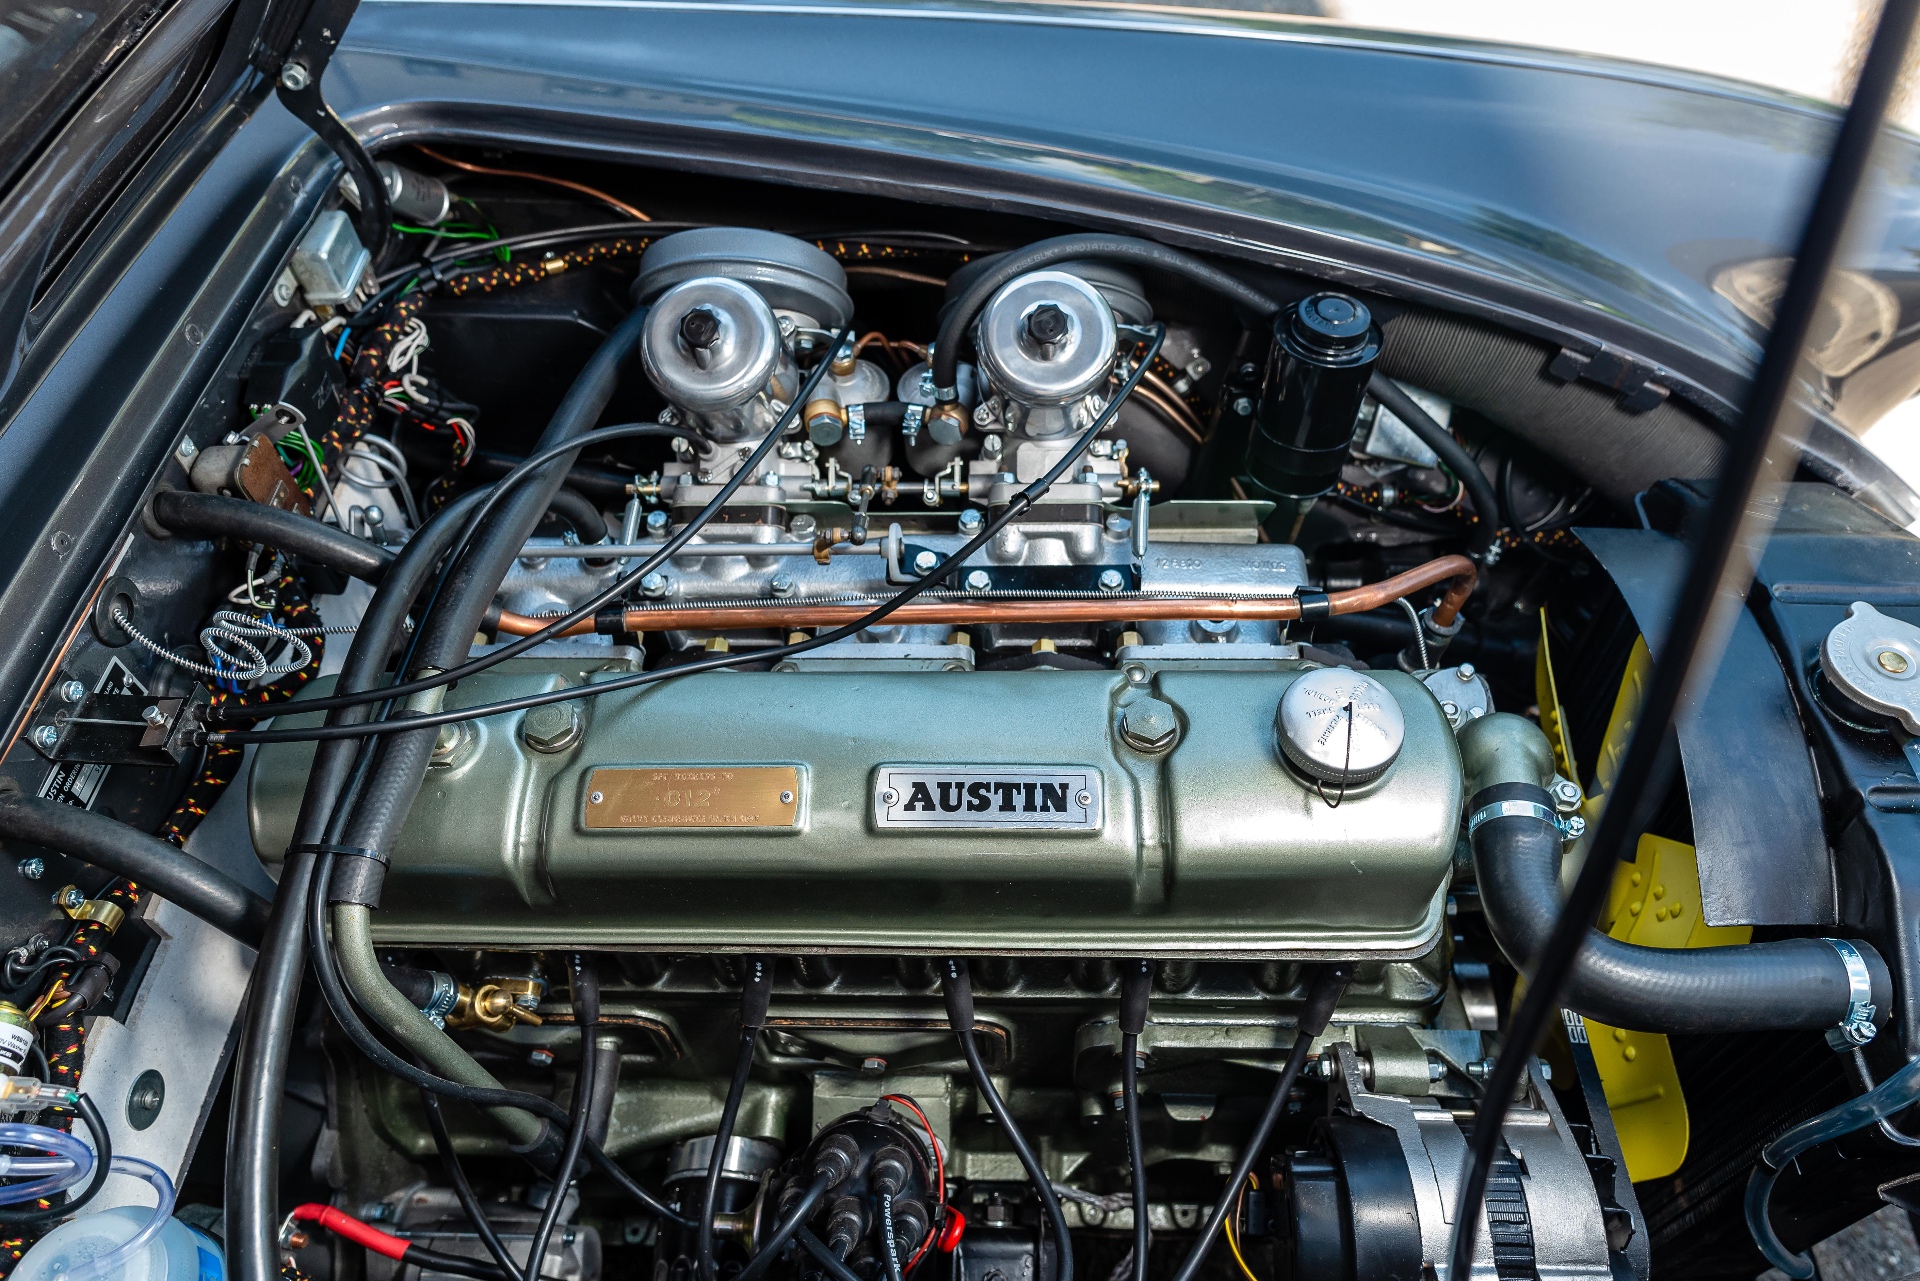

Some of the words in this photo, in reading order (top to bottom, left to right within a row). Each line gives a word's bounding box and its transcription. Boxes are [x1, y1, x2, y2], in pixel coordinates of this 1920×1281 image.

[1306, 706, 1335, 718] SHELL
[46, 770, 66, 800] USTIN
[63, 764, 81, 792] ORDERIN
[903, 781, 1070, 813] AUSTIN
[883, 1193, 901, 1272] Powerspark
